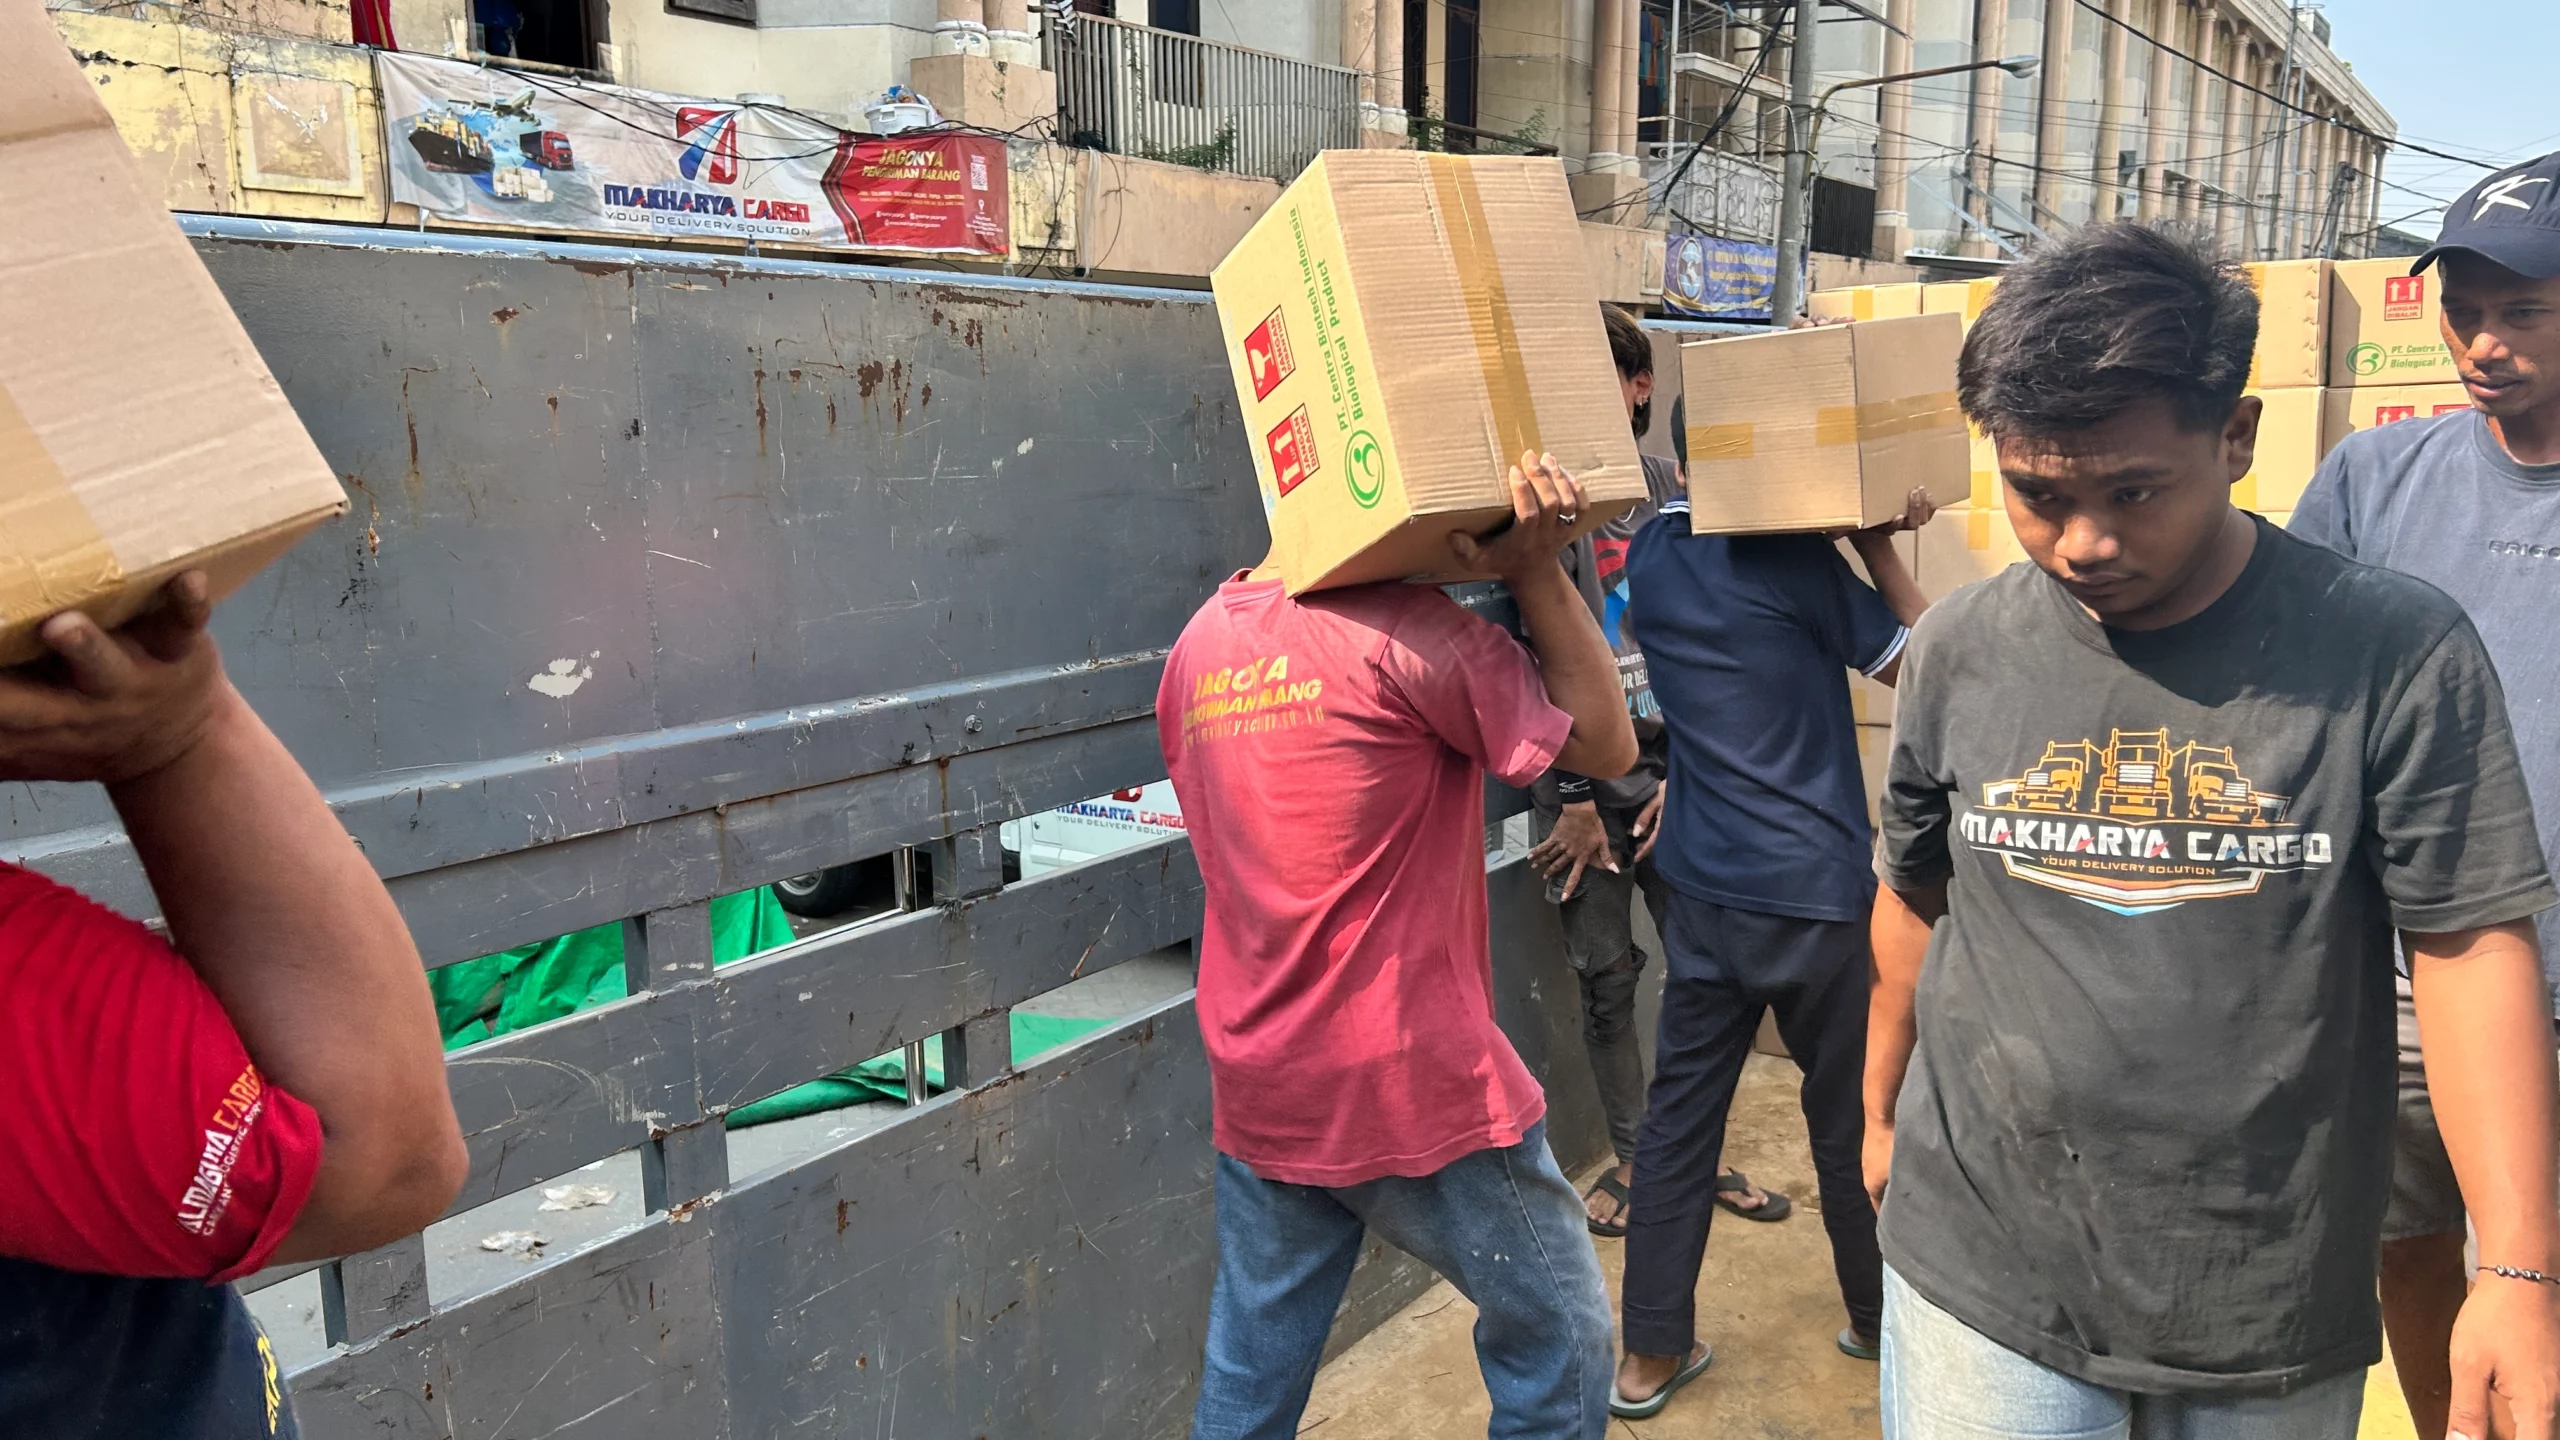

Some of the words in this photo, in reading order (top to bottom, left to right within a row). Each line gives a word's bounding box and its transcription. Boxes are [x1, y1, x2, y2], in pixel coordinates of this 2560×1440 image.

[879, 149, 943, 167] JAGONYA
[921, 169, 961, 182] BARANG
[604, 184, 737, 218] MAKHARYA
[743, 199, 810, 223] CARGO
[605, 211, 650, 223] YOUR
[656, 216, 732, 230] DELIVERY
[737, 223, 811, 236] SOLUTION
[1289, 207, 1313, 285] Indonesia
[1316, 259, 1341, 328] Product
[1276, 314, 1292, 371] DIBANTING
[1306, 290, 1328, 348] Biotech
[1270, 318, 1287, 374] JANGAN
[2390, 358, 2436, 368] Biological
[2391, 345, 2403, 354] PT.
[2406, 344, 2436, 354] Centra
[1326, 358, 1342, 405] Centra
[1334, 336, 1364, 421] Biological
[1300, 413, 1317, 468] DIBALIK
[1336, 405, 1348, 431] PT.
[1294, 416, 1311, 471] JANGAN
[1056, 815, 1085, 825] YOUR
[1086, 819, 1133, 831] DELIVERY
[1960, 811, 2172, 860] MAKHARYA
[2186, 831, 2333, 865] CARGO
[2040, 855, 2077, 869] YOUR
[2081, 859, 2145, 873] DELIVERY
[2148, 864, 2216, 876] SOLUTION
